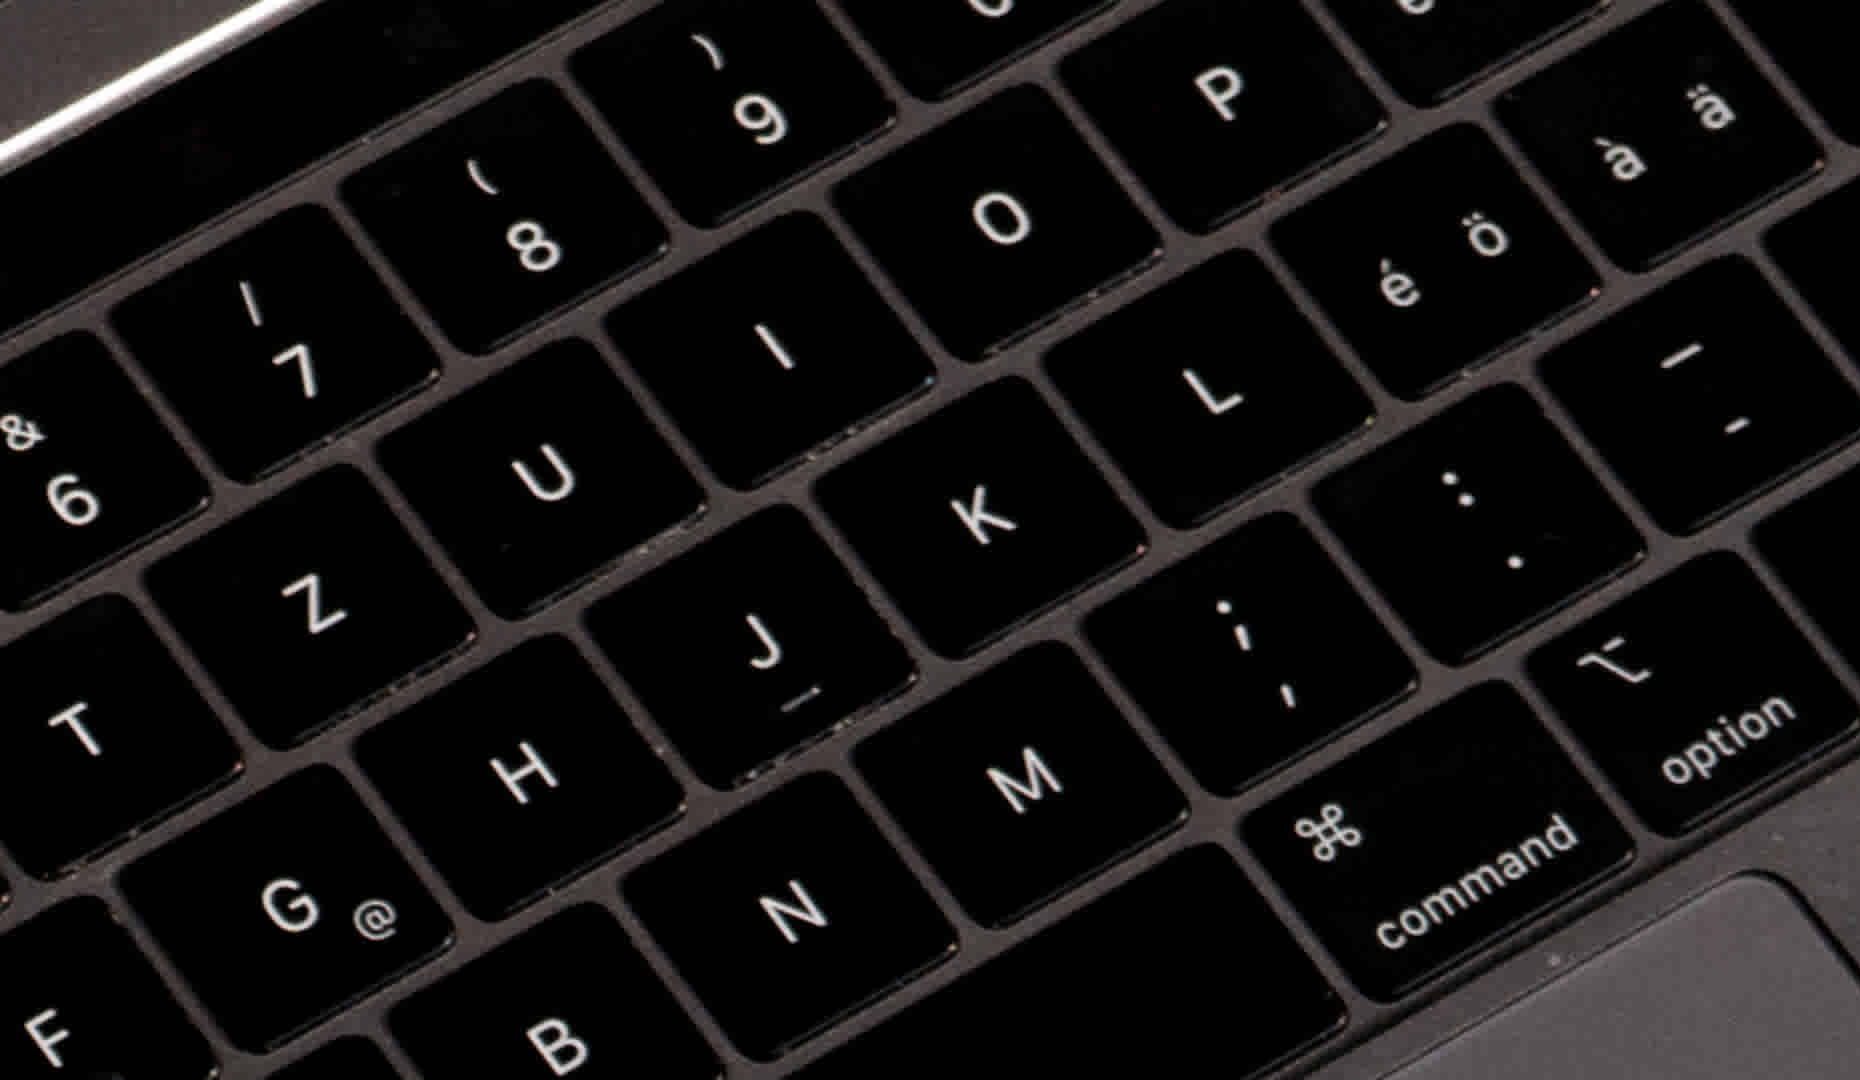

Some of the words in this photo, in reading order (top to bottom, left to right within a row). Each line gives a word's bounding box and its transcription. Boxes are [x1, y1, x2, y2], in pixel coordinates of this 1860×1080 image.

[692, 34, 722, 70] )
[733, 94, 787, 146] 9
[1194, 66, 1242, 122] P
[1593, 135, 1647, 181] à
[1685, 82, 1735, 130] ä
[467, 160, 498, 196] (
[506, 220, 562, 273] 8
[972, 192, 1031, 246] O
[1380, 257, 1421, 308] é
[1460, 211, 1508, 258] ö
[238, 281, 262, 327] /
[271, 342, 317, 399] 7
[754, 323, 794, 370] I
[1182, 369, 1244, 415] L
[0, 414, 45, 452] &
[46, 473, 100, 527] 6
[510, 443, 575, 502] U
[1442, 471, 1474, 507] :
[950, 485, 1018, 546] K
[281, 573, 347, 635] Z
[1216, 600, 1251, 651] ;
[745, 614, 781, 670] J
[1280, 684, 1296, 708] ,
[47, 701, 101, 757] T
[1661, 690, 1796, 785] option
[489, 741, 558, 805] H
[986, 746, 1062, 814] M
[261, 878, 320, 933] G
[352, 899, 396, 941] @
[1376, 814, 1578, 950] command
[758, 879, 828, 944] N
[23, 1008, 70, 1068] F
[526, 1017, 588, 1077] B
